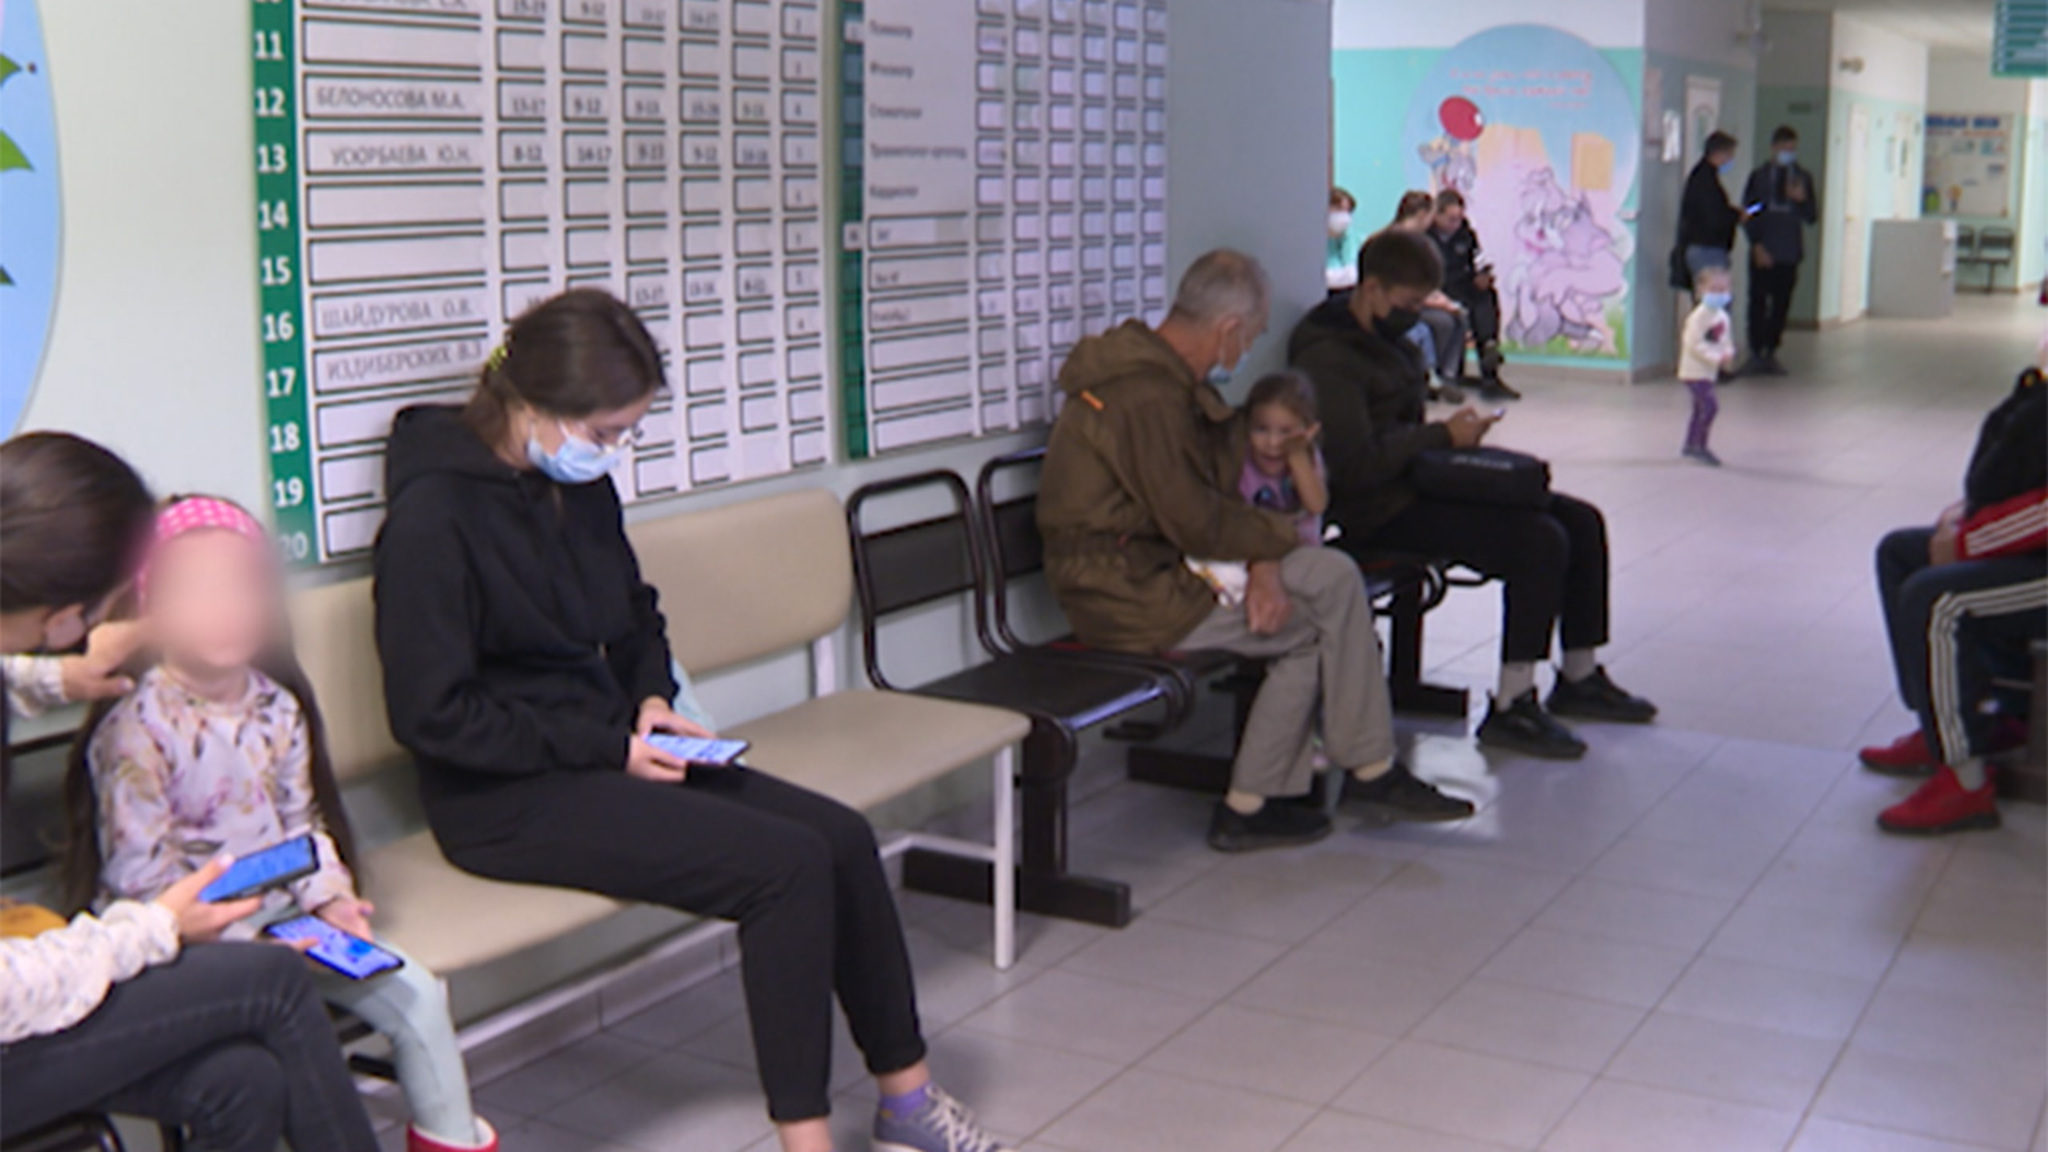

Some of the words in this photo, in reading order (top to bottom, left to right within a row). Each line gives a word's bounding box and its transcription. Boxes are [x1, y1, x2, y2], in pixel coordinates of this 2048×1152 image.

[255, 31, 284, 60] 11
[256, 88, 286, 117] 12
[316, 86, 427, 110] БЕЛОНОСОВА
[258, 145, 288, 173] 13
[329, 144, 428, 166] УСЮРБАЕВА
[259, 201, 289, 230] 14
[262, 256, 292, 286] 15
[264, 312, 294, 342] 16
[321, 300, 432, 331] ШАЙДУРОВА
[267, 367, 296, 397] 17
[270, 422, 301, 452] 18
[275, 477, 305, 507] 19
